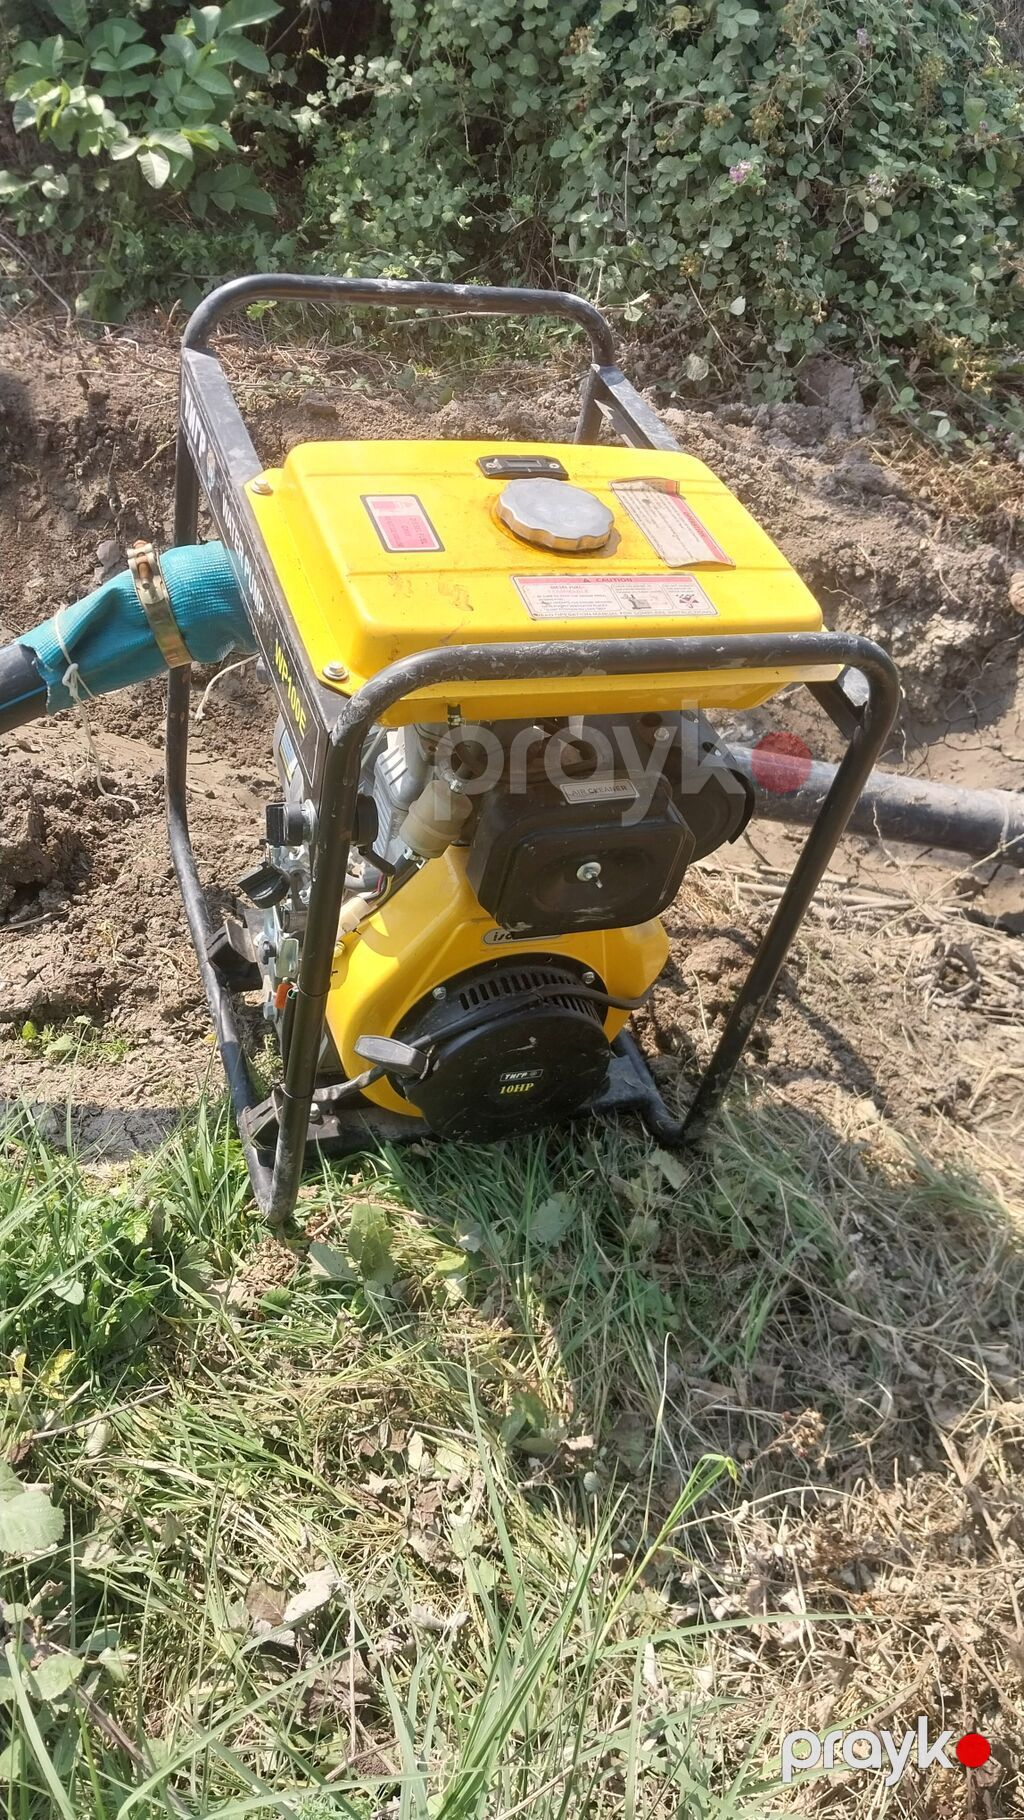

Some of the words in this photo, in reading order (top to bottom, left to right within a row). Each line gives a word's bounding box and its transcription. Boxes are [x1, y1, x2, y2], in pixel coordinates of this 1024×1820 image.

[222, 493, 244, 569] WATER
[244, 555, 264, 616] PUMP
[275, 638, 306, 739] WP100E
[588, 785, 628, 794] CLEANER
[500, 1082, 534, 1095] 10HP
